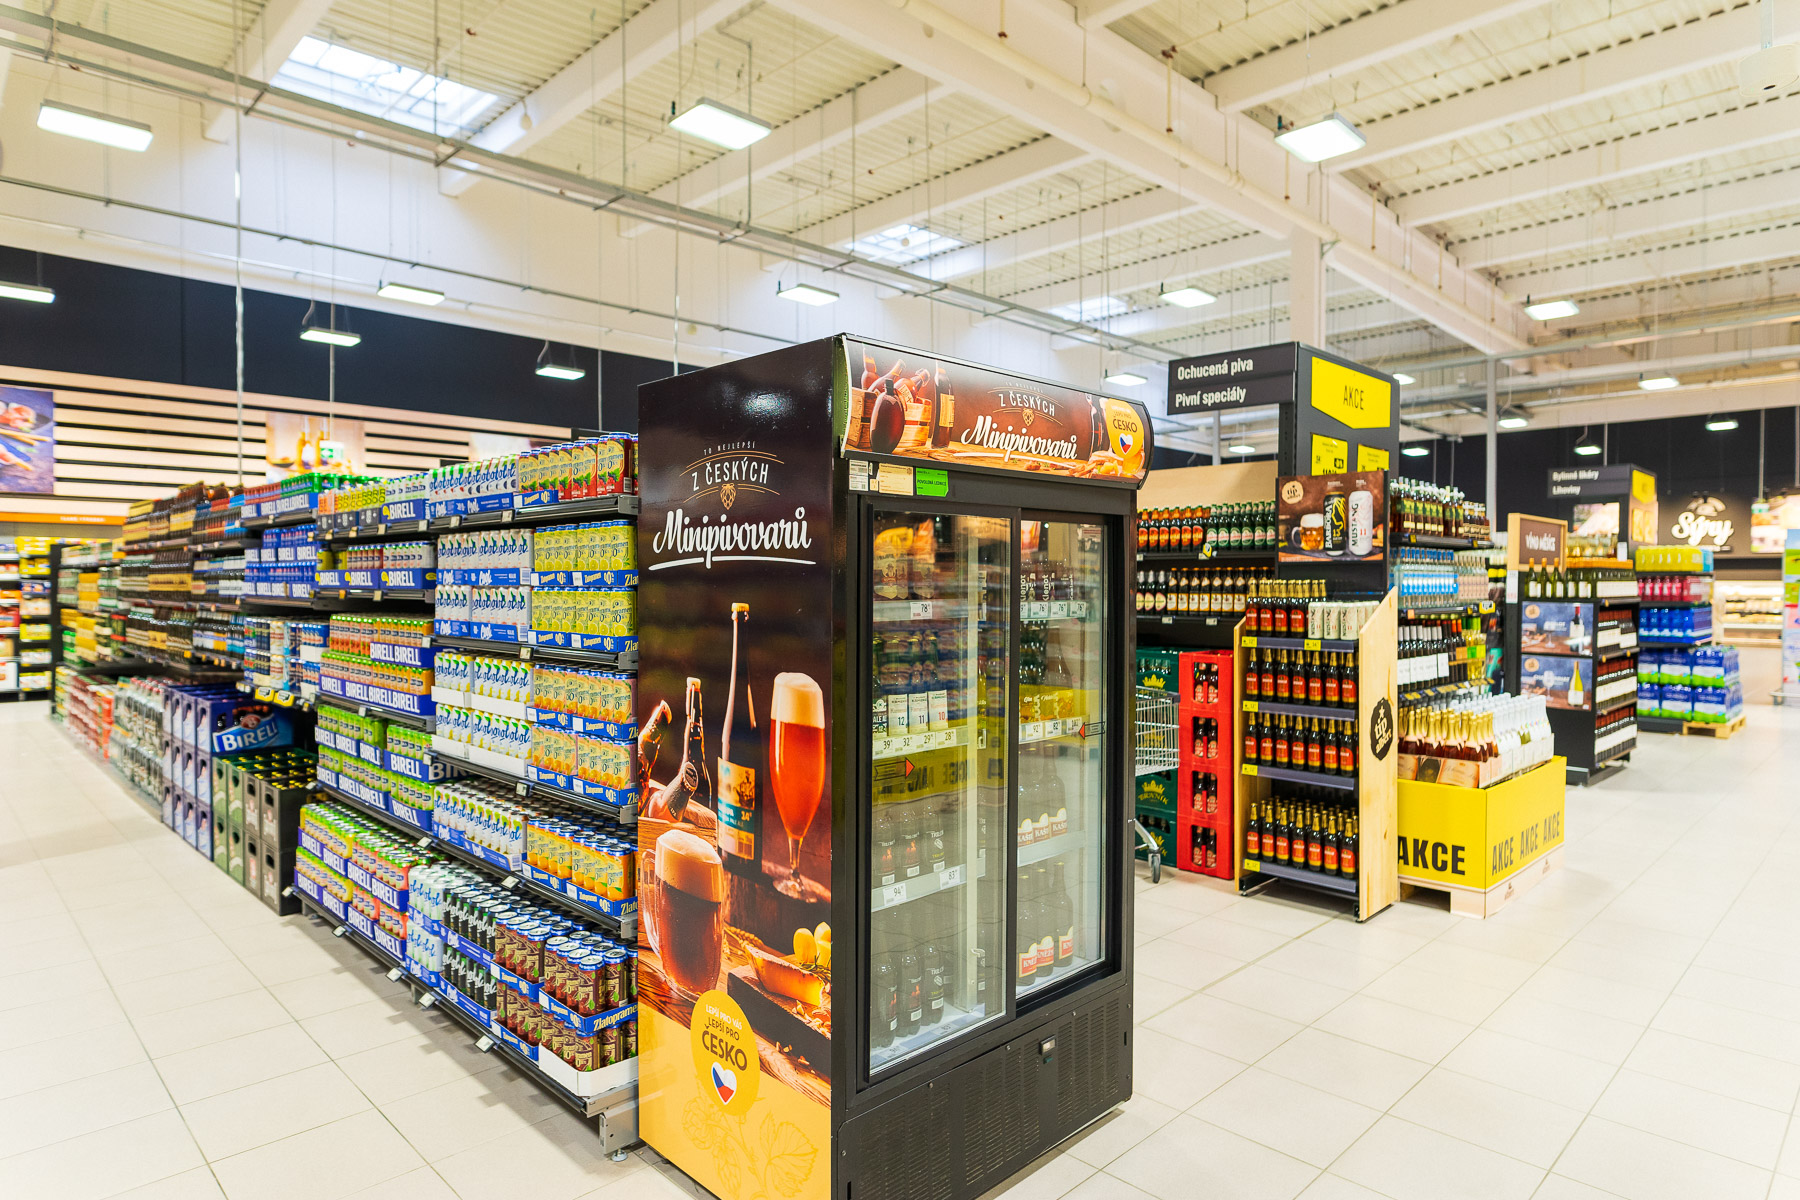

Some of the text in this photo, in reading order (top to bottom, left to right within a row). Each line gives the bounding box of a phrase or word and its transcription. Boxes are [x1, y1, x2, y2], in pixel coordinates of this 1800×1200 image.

[1177, 357, 1254, 381] Ochucená piva
[998, 390, 1056, 417] Z ČESKÝCH
[1175, 385, 1247, 408] Pivní speciály
[1343, 384, 1365, 411] AKCE
[703, 447, 712, 456] TO
[960, 415, 1078, 463] Minipivovarů
[691, 456, 769, 492] Z ČESKÝCH
[389, 501, 416, 520] BIRELL
[652, 506, 812, 569] Minipivovarů
[1351, 503, 1359, 546] MUSTANG
[350, 571, 374, 586] BIRELL
[388, 570, 416, 587] BIRELL
[370, 642, 395, 662] BIRELL
[394, 645, 422, 666] BIRELL
[321, 675, 344, 695] BIRELL
[345, 681, 369, 702] BIRELL
[368, 685, 393, 706] BIRELL
[392, 691, 420, 714] BIRELL
[221, 719, 278, 751] BIRELL
[335, 733, 358, 757] BIRELL
[390, 753, 423, 779] BIRELL
[359, 784, 386, 810] BIRELL
[391, 799, 421, 827] BIRELL
[301, 831, 322, 858] BIRELL
[1397, 834, 1466, 876] AKCE
[1492, 810, 1561, 877] AKCE AKCE AKCE
[323, 846, 346, 876] BIRELL
[297, 872, 320, 900] BIRELL
[347, 861, 372, 892] BIRELL
[322, 887, 346, 920] BIRELL
[371, 875, 401, 910] BIRELL
[347, 904, 373, 938] BIRELL
[373, 923, 403, 959] BIRELL
[593, 1004, 638, 1032] Zlatoprame
[708, 1016, 740, 1041] LEPŠÍ PRO
[720, 1009, 732, 1025] PRO
[701, 1023, 748, 1071] ČESKO
